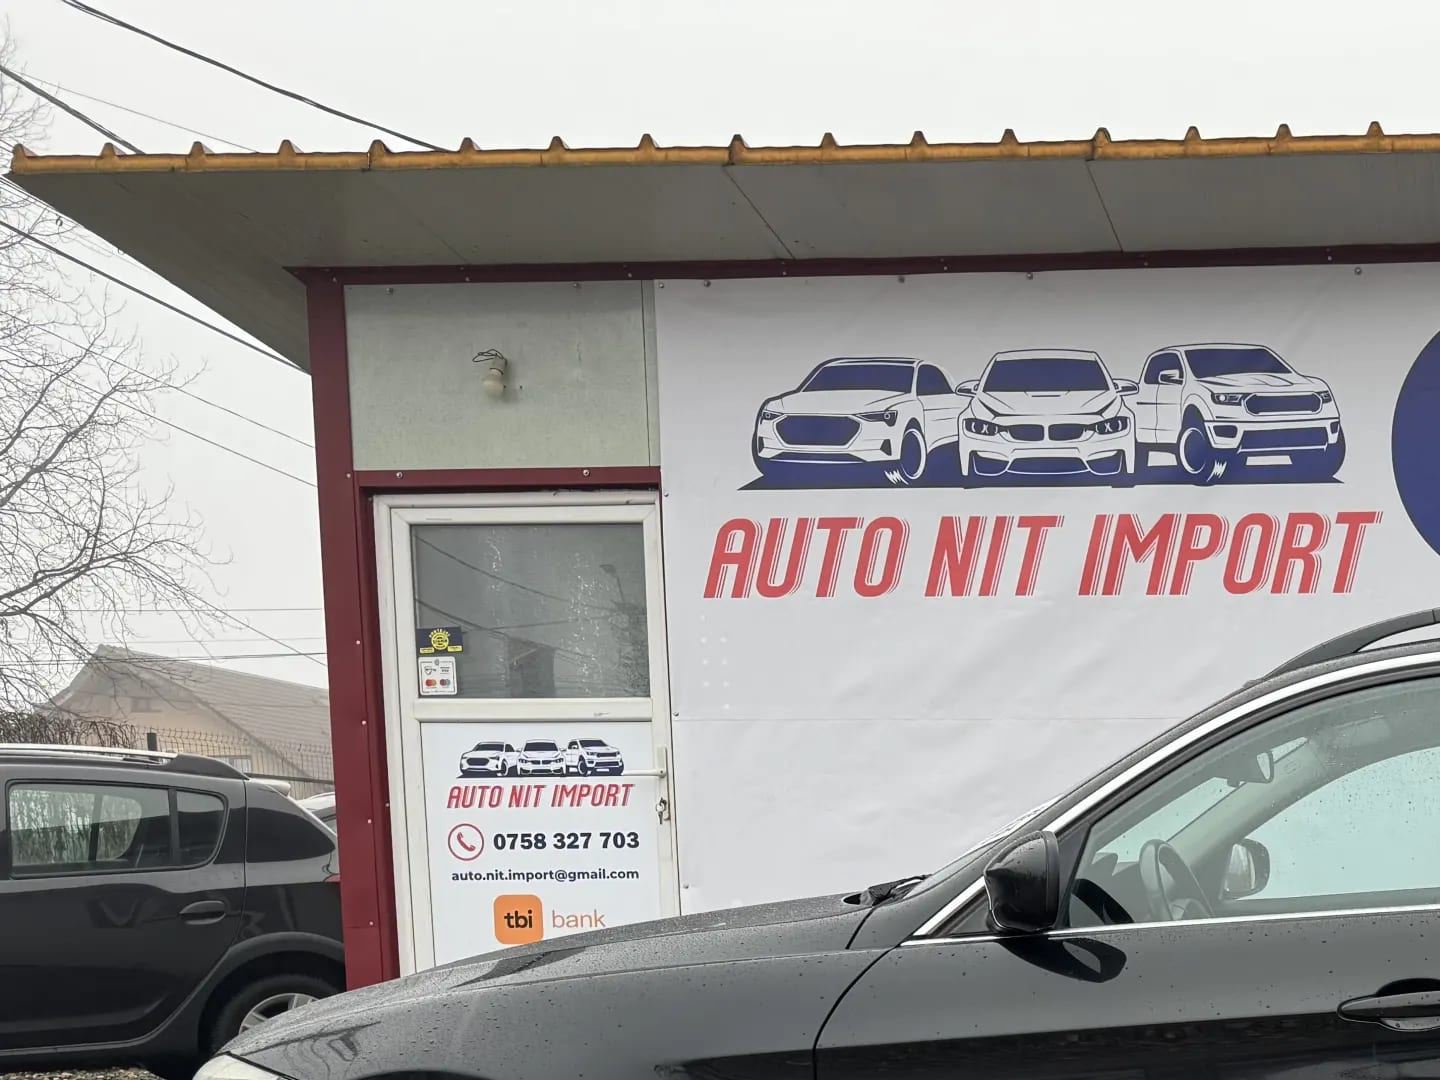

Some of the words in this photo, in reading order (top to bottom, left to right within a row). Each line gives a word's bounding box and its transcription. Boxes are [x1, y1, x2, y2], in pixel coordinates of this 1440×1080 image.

[703, 517, 910, 598] AUTO
[924, 515, 1064, 597] NIT
[1078, 511, 1383, 597] IMPORT
[447, 785, 503, 809] AUTO
[508, 784, 547, 808] NIT
[551, 783, 636, 807] IMPORT
[493, 833, 547, 850] 0758
[553, 832, 592, 849] 327
[599, 832, 640, 849] 703
[451, 868, 640, 882] auto.nit.import@gmail.com
[504, 909, 533, 928] tbi
[552, 909, 606, 928] bank
